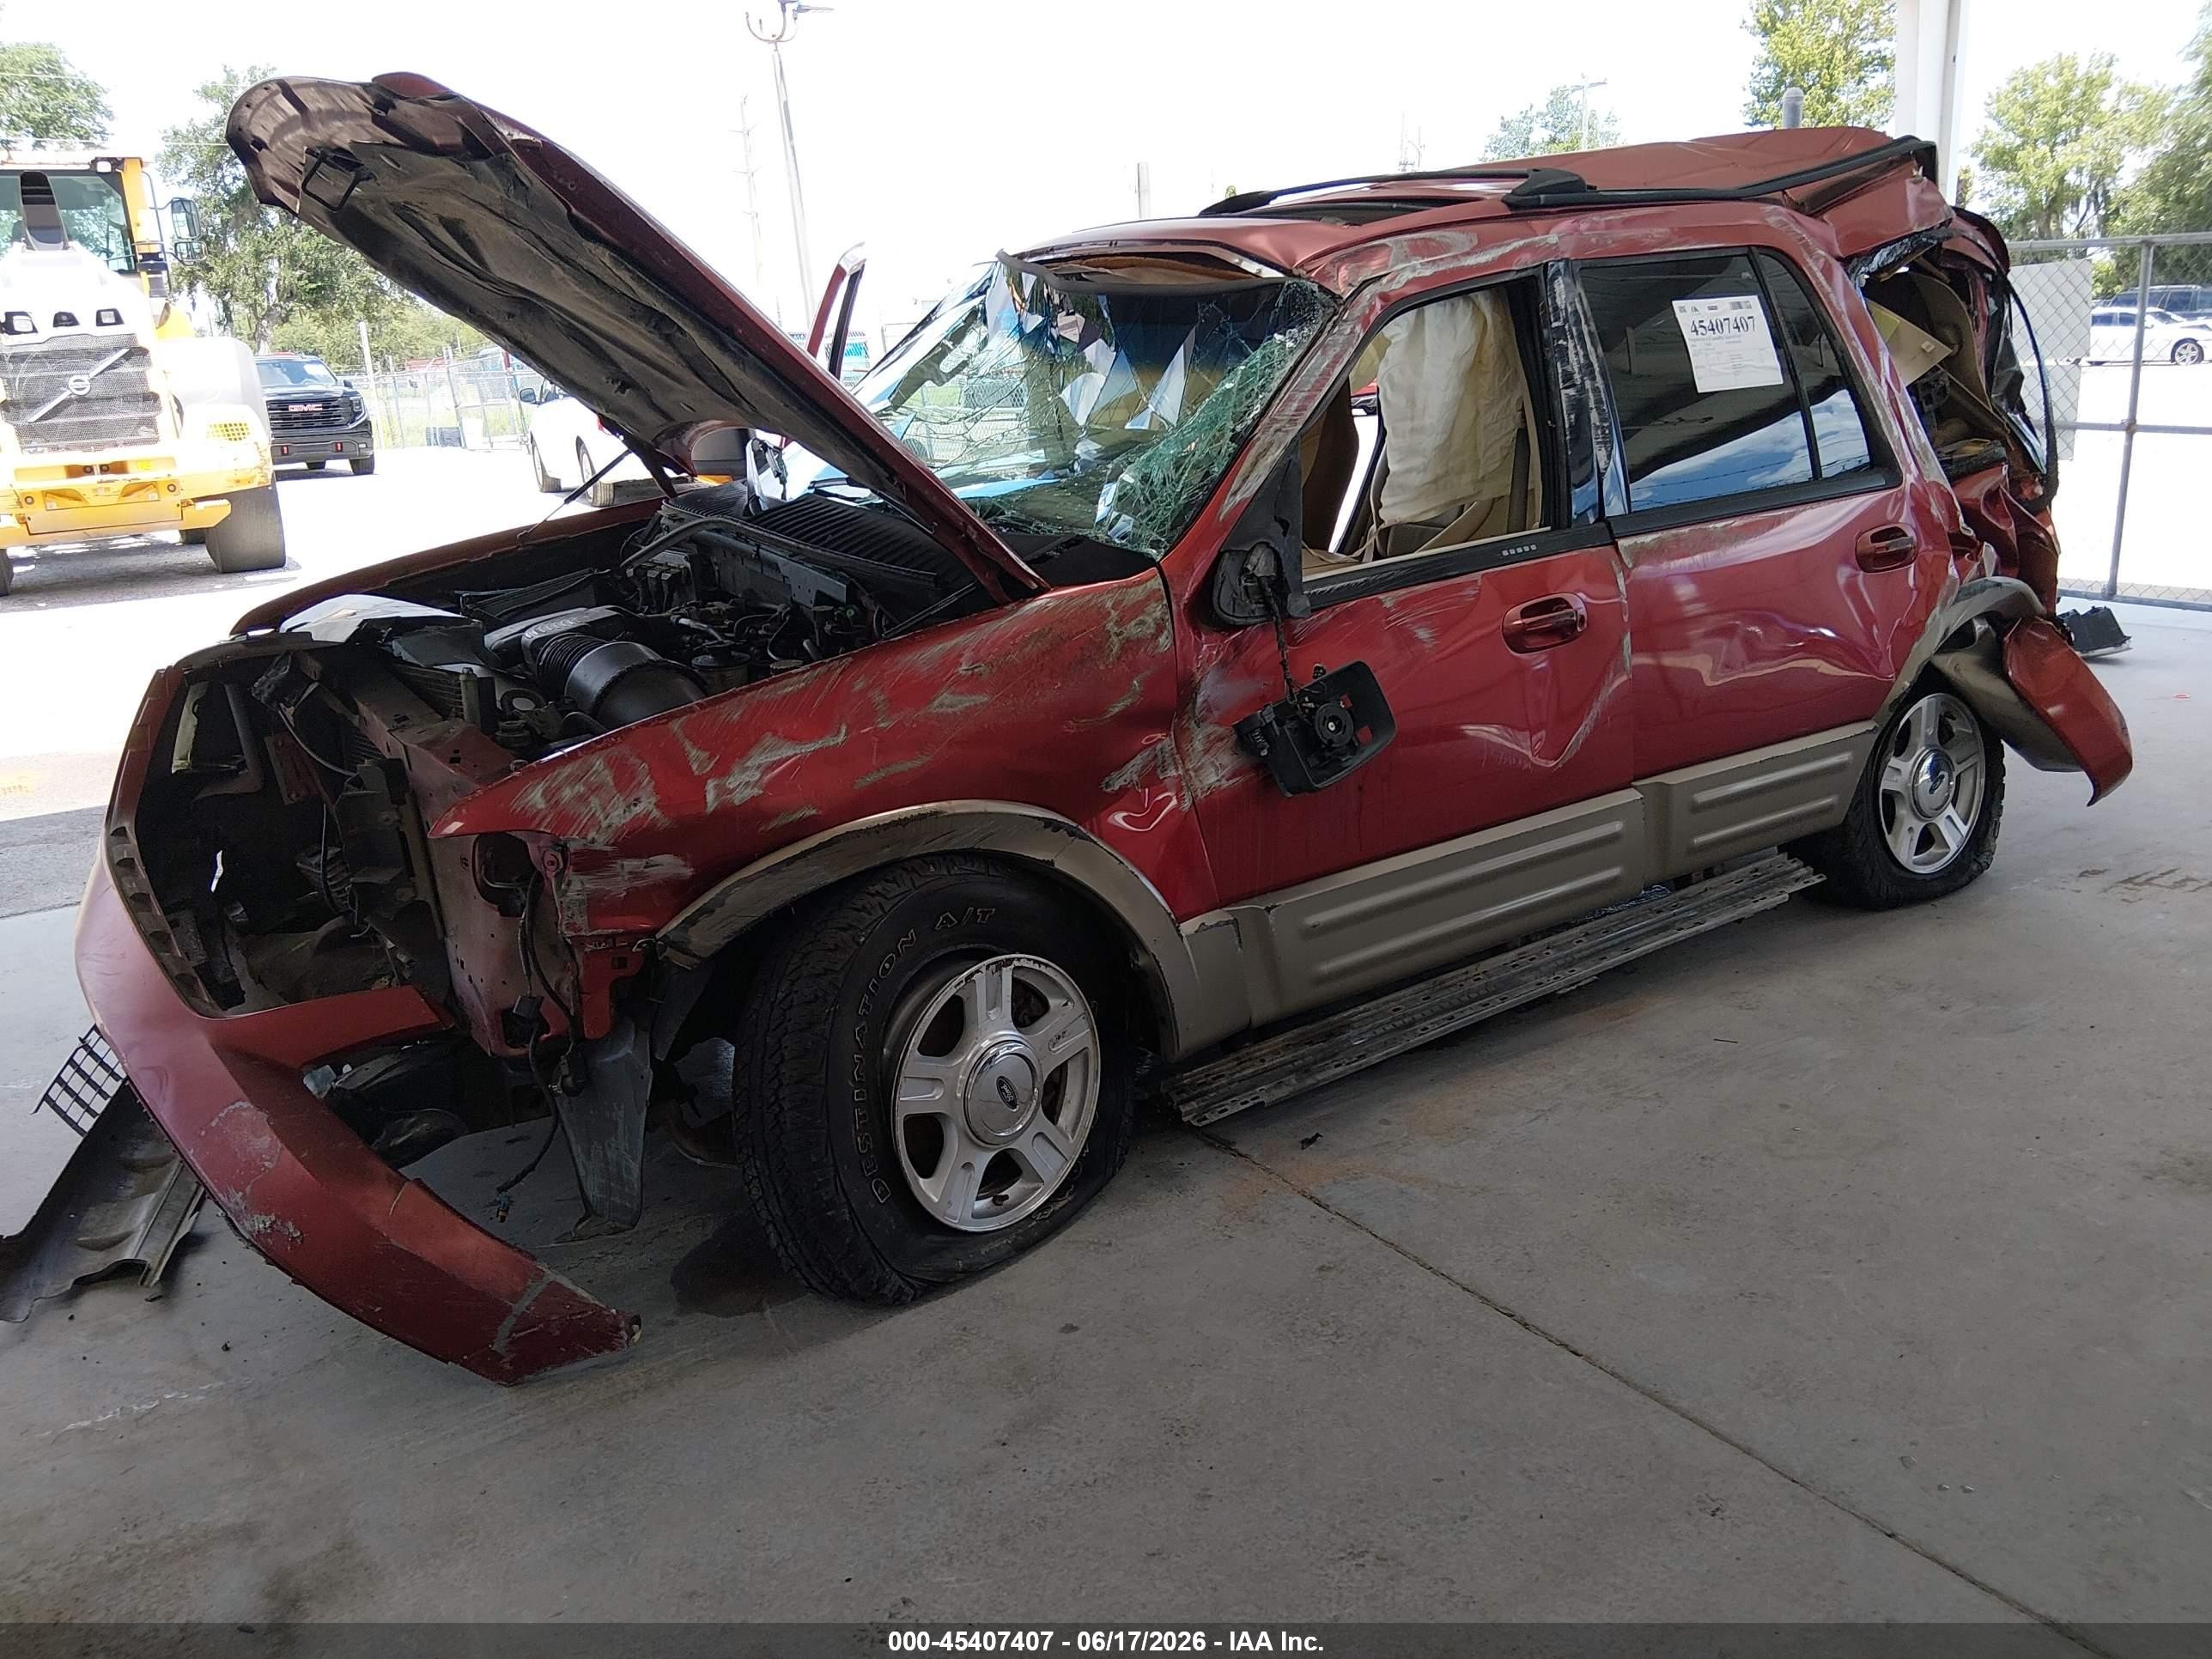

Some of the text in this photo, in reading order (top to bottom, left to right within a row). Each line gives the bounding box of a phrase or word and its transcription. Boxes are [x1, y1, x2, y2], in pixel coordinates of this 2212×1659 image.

[1690, 315, 1756, 336] 45407407
[852, 907, 996, 1204] DESTINATION A/T
